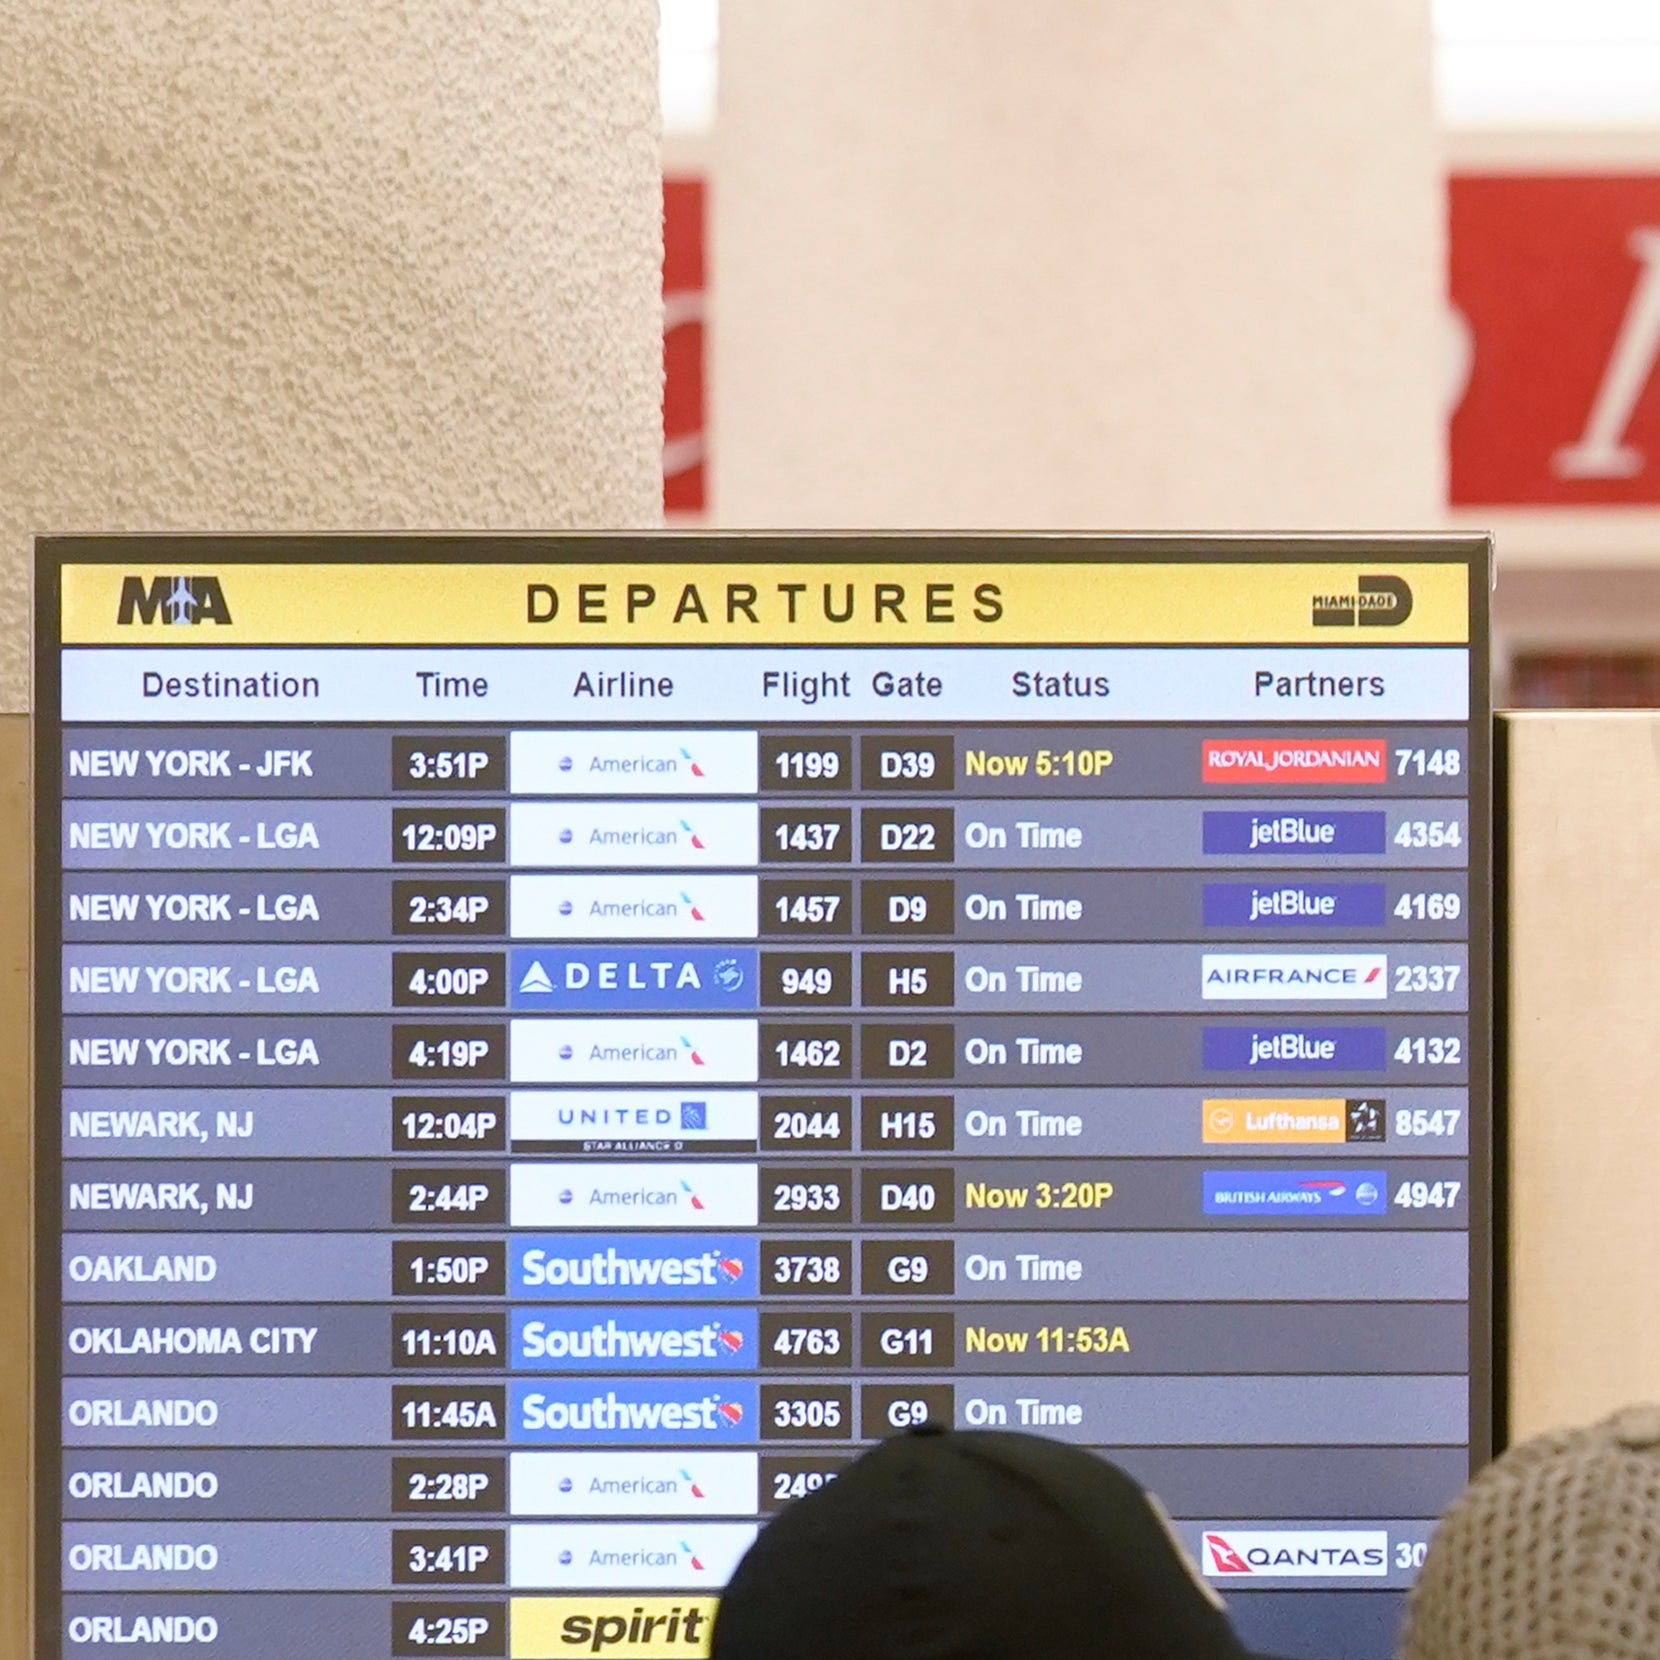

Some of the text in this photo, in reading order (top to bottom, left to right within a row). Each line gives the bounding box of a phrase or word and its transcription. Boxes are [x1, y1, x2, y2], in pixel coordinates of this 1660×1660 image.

[526, 582, 1006, 627] DEPARTURES
[144, 672, 318, 697] Destination
[416, 672, 487, 697] Time
[574, 672, 673, 697] Airline
[764, 672, 850, 704] Flight
[873, 672, 942, 697] Gate
[1013, 672, 1109, 697] Status
[1256, 671, 1384, 696] Partners
[70, 750, 139, 776] NEW
[146, 750, 231, 776] YORK
[256, 750, 312, 776] JFK
[410, 752, 488, 778] 3:51P
[590, 756, 677, 772] American
[776, 752, 838, 778] 1199
[881, 752, 934, 777] D39
[966, 750, 1113, 776] Now 5:10P
[1209, 750, 1379, 771] ROYAL JORDANIAN
[1396, 750, 1460, 775] 7148
[1250, 818, 1334, 848] jetBlue
[409, 969, 488, 994] 4:00P
[566, 963, 700, 988] DELTA
[782, 968, 831, 994] 949
[890, 968, 927, 994] H5
[965, 966, 1082, 992] On Time
[1208, 969, 1355, 983] AIRFRANCE
[1395, 966, 1460, 991] 2337
[70, 1111, 253, 1143] NEWARK, NJ
[403, 1113, 496, 1138] 12:04P
[559, 1109, 671, 1124] UNITED
[774, 1113, 840, 1138] 2044
[882, 1113, 935, 1138] H15
[1246, 1112, 1340, 1130] Lufthansa
[1396, 1110, 1460, 1135] 8547
[1215, 1192, 1321, 1203] BRITISH AIRWAYS
[1394, 1182, 1460, 1207] 4947
[69, 1256, 216, 1281] OAKLAND
[523, 1248, 720, 1285] Southwest
[888, 1257, 927, 1282] G9
[69, 1328, 317, 1353] OKLAHOMA CITY
[403, 1330, 496, 1355] 11:10A
[967, 1327, 1129, 1352] Now 11:53A
[69, 1472, 218, 1498] ORLANDO
[1247, 1548, 1383, 1565] QANTAS
[561, 1607, 703, 1652] spirit
